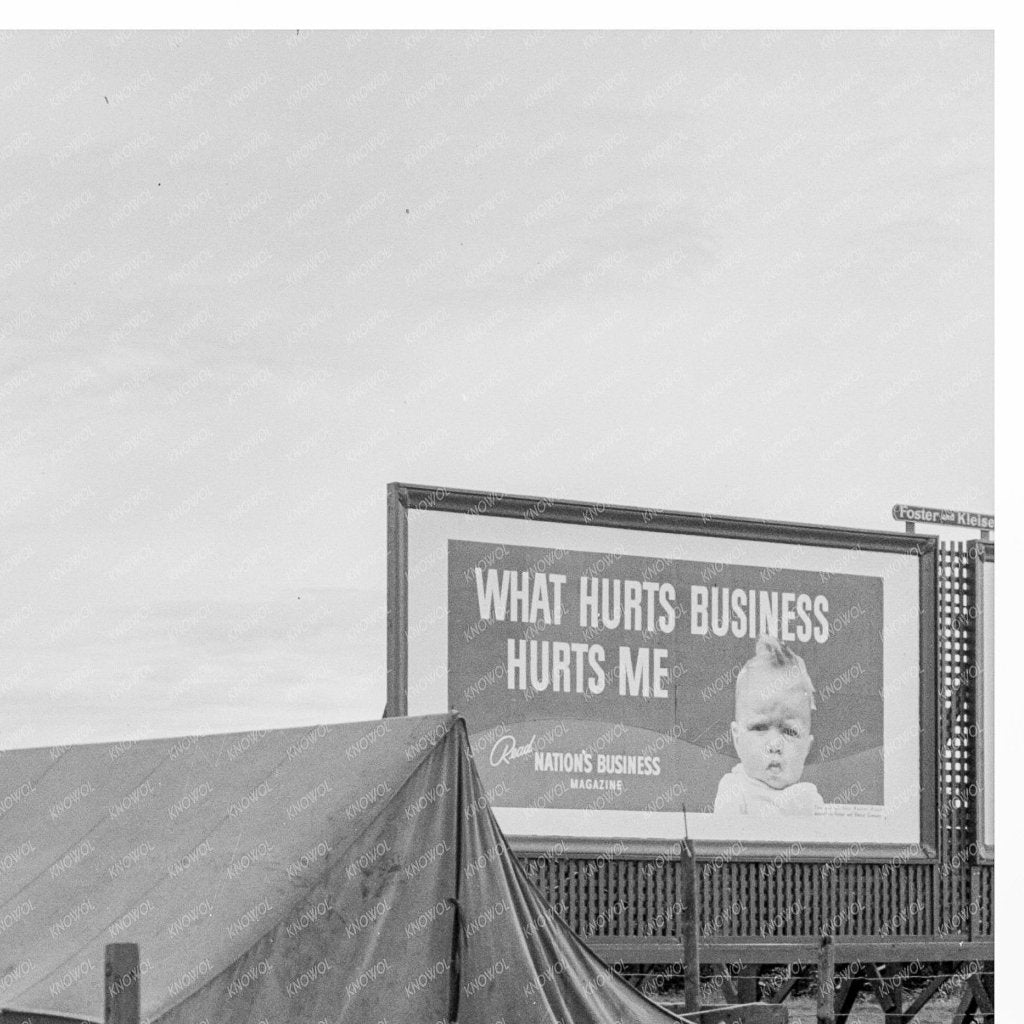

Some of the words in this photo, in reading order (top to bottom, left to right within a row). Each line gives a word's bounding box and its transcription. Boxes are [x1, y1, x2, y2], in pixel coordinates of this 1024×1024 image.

[898, 504, 939, 522] Foster
[475, 567, 567, 626] WHAT
[579, 576, 676, 634] HURTS
[690, 584, 829, 644] BUSINESS
[507, 638, 606, 695] HURTS
[619, 646, 669, 698] ME
[489, 734, 536, 767] Read
[534, 749, 593, 773] NATION'S
[597, 754, 661, 776] BUSINESS
[570, 778, 623, 790] MAGAZINE
